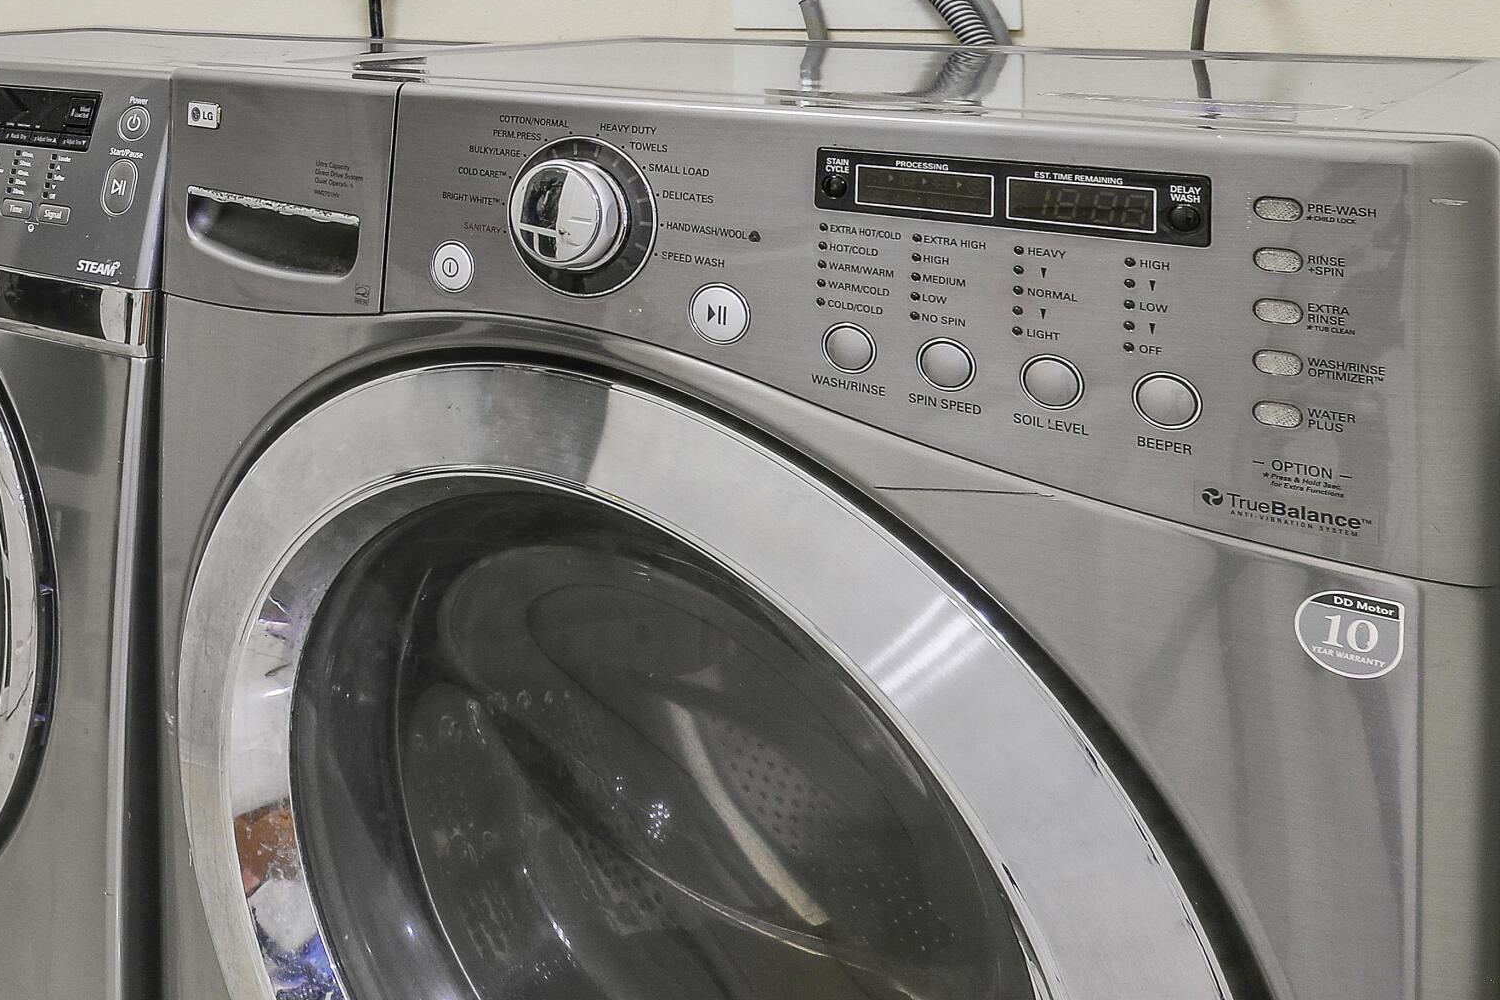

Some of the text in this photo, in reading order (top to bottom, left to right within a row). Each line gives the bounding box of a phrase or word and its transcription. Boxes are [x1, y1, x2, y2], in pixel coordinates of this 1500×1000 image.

[129, 95, 149, 105] Power
[202, 110, 214, 121] LG
[499, 114, 570, 129] COTTON/NORMAL
[492, 128, 542, 141] PERM.PRESS
[600, 122, 658, 136] HEAVY DUTY
[109, 146, 144, 160] Start/Pause
[469, 144, 521, 158] BULKY/LARGE
[629, 141, 668, 153] TOWELS
[329, 161, 350, 172] Capacity
[825, 164, 850, 174] CYCLE
[826, 157, 850, 167] STAIN
[895, 160, 949, 171] PROCESSING
[330, 170, 344, 179] Drive
[344, 172, 364, 182] System
[458, 166, 479, 176] COLD
[648, 163, 710, 178] SMALL LOAD
[1034, 170, 1124, 186] EST. TIME REMAINING
[442, 190, 468, 202] BRIGHT
[1169, 184, 1201, 195] DELAY
[662, 189, 715, 205] DELICATES
[1169, 193, 1201, 204] WASH
[9, 204, 23, 214] Time
[43, 208, 63, 220] Signal
[1307, 203, 1377, 218] PRE-WASH
[1313, 215, 1357, 225] CHILD LOCK
[463, 221, 502, 235] SANITARY
[829, 224, 902, 241] EXTRA HOT/COLD
[923, 235, 986, 250] EXTRA HIGH
[829, 243, 879, 257] HOT/COLD
[1027, 246, 1066, 259] HEAVY
[661, 250, 726, 269] SPEED WASH
[923, 254, 950, 266] HIGH
[1140, 259, 1170, 271] HIGH
[1308, 254, 1346, 267] RINSE
[76, 259, 117, 277] STEAM
[828, 261, 895, 278] WARM/WARM
[1308, 266, 1344, 278] +SPIN
[922, 273, 966, 287] MEDIUM
[827, 280, 890, 297] WARM/COLD
[1027, 287, 1078, 302] NORMAL
[922, 293, 948, 305] LOW
[827, 299, 884, 315] COLD/COLD
[1139, 302, 1168, 313] LOW
[1307, 302, 1350, 316] EXTRA
[921, 313, 966, 327] NO SPIN
[1307, 314, 1346, 326] RINSE
[1026, 328, 1060, 341] LIGHT
[1314, 325, 1356, 336] TUB CLEAN
[1139, 344, 1162, 355] OFF
[1307, 357, 1386, 376] WASH/RINSE
[811, 373, 886, 397] WASH/RINSE
[908, 392, 982, 415] SPIN SPEED
[1307, 407, 1356, 423] WATER
[1013, 412, 1089, 436] SOIL LEVEL
[1308, 418, 1344, 433] PLUS
[1137, 435, 1192, 455] BEEPER
[1271, 459, 1332, 479] OPTION
[1270, 473, 1292, 482] Press
[1293, 476, 1300, 484] &
[1302, 478, 1321, 487] Hold
[1283, 482, 1304, 491] Extra
[1305, 486, 1344, 498] Functions
[1230, 509, 1313, 529] ANTI-VIBRATION
[1319, 525, 1359, 537] SYSTEM
[1333, 595, 1395, 616] DD Motor
[1322, 614, 1379, 653] 10
[1311, 645, 1386, 668] YEAR WARRANTY
